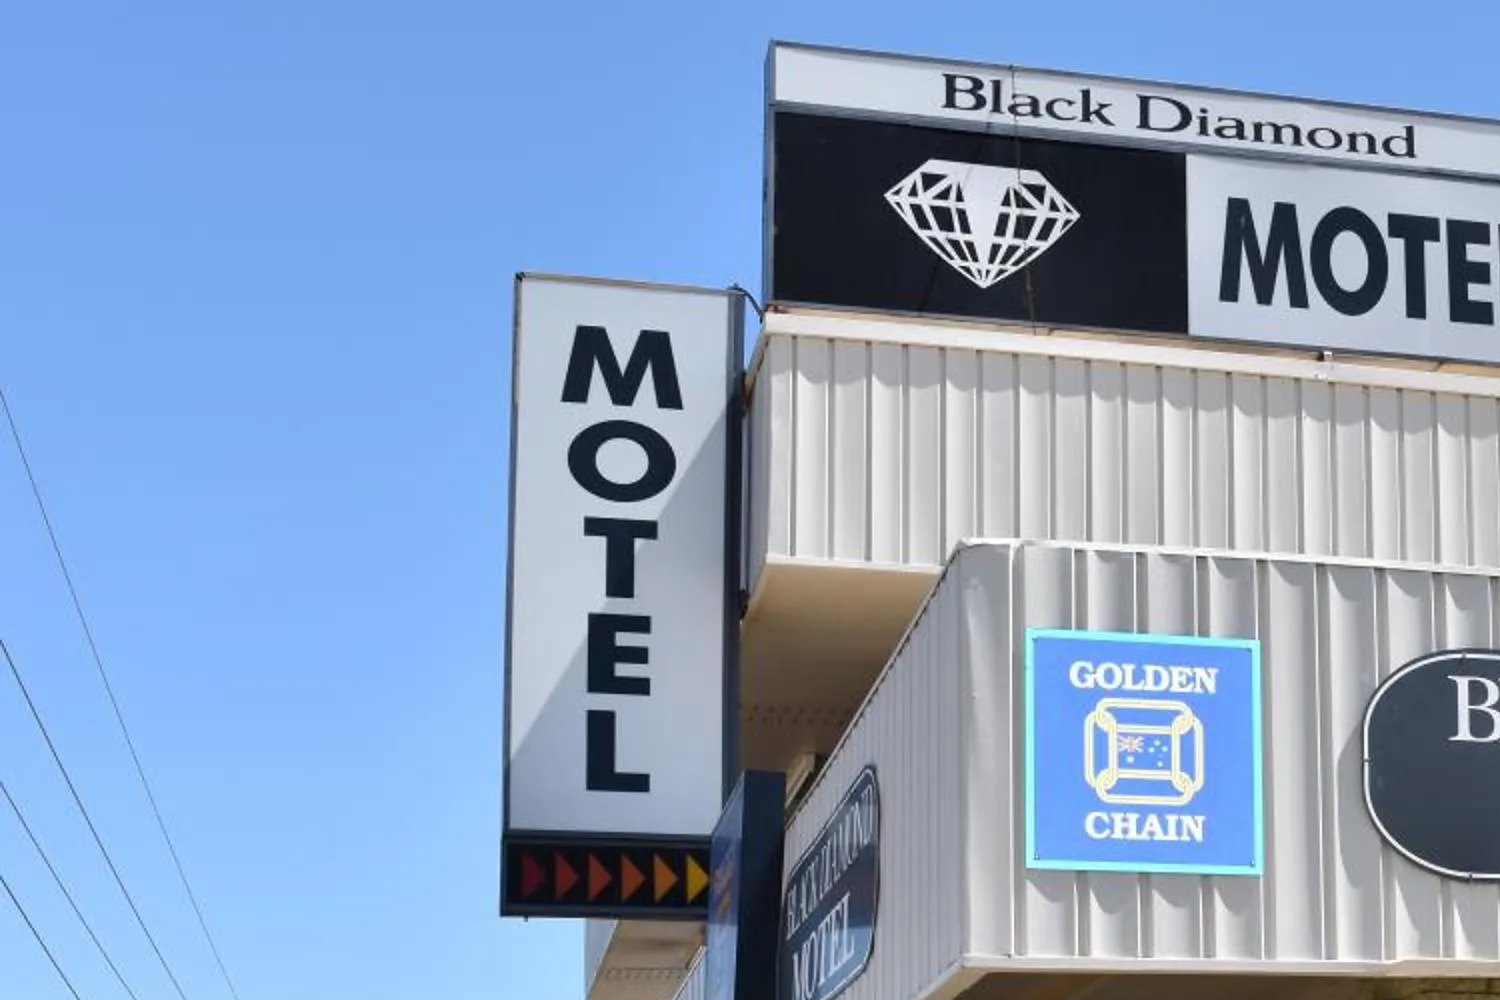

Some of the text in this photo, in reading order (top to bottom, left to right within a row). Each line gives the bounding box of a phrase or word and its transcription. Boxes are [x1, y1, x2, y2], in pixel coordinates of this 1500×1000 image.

[942, 73, 1419, 159] Black Diamond
[560, 324, 684, 793] MOTEL
[1069, 660, 1218, 694] GOLDEN
[819, 783, 873, 893] DIAMOND
[1084, 810, 1206, 843] CHAIN
